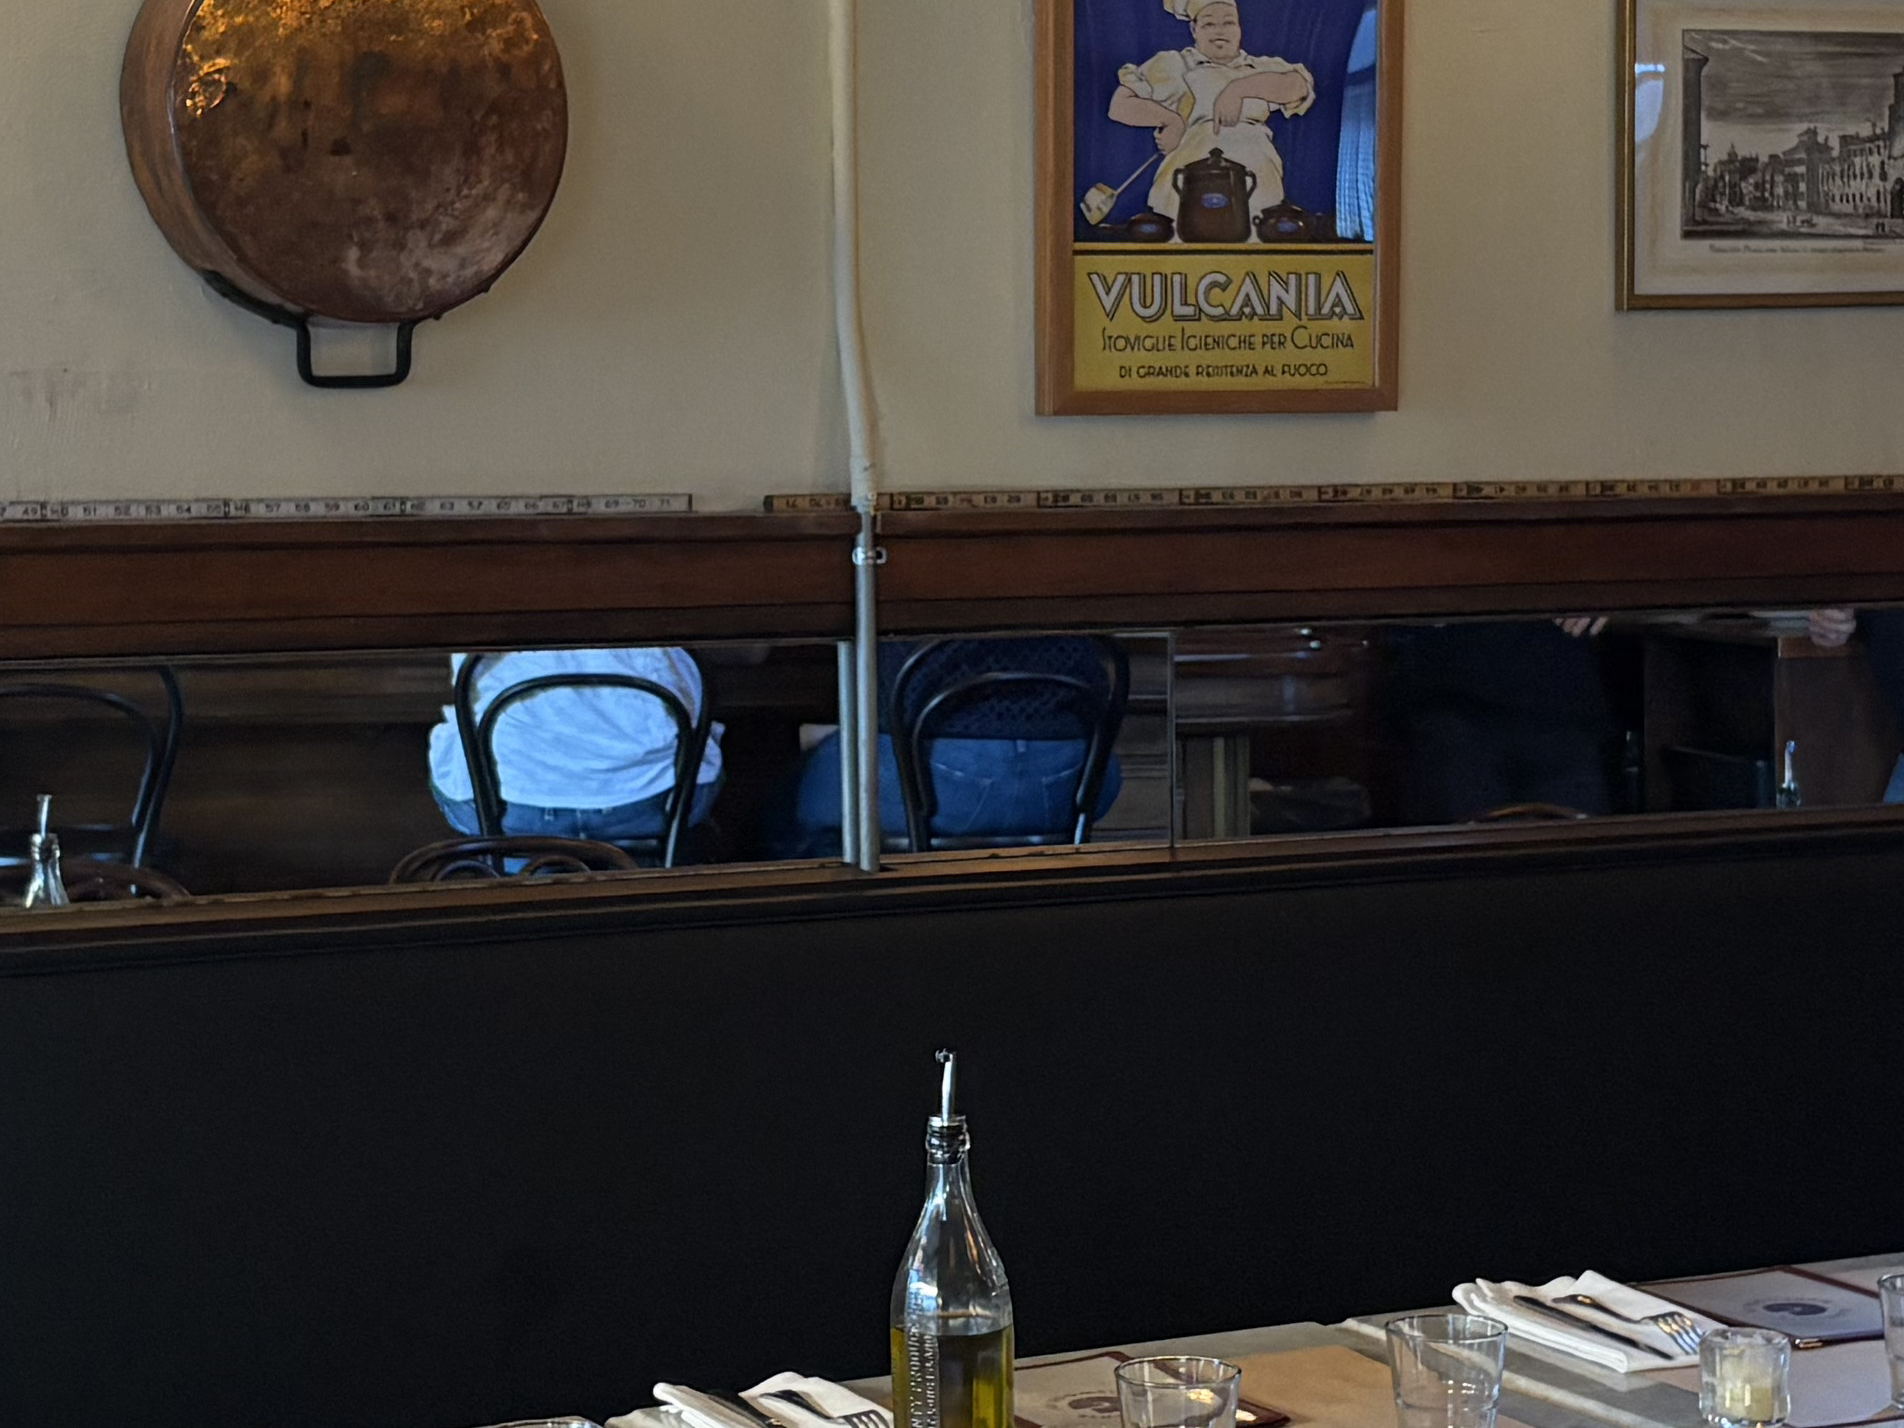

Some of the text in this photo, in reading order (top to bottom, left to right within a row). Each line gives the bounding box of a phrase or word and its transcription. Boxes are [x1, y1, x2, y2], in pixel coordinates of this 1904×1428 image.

[1087, 271, 1364, 322] VULCANIA
[1102, 325, 1355, 353] STOVIGLIE IGIENICHE PER CUCINA
[1119, 366, 1132, 379] DI
[1136, 365, 1190, 378] GRANDE
[1263, 364, 1278, 377] AL
[1281, 363, 1328, 377] FUOCO
